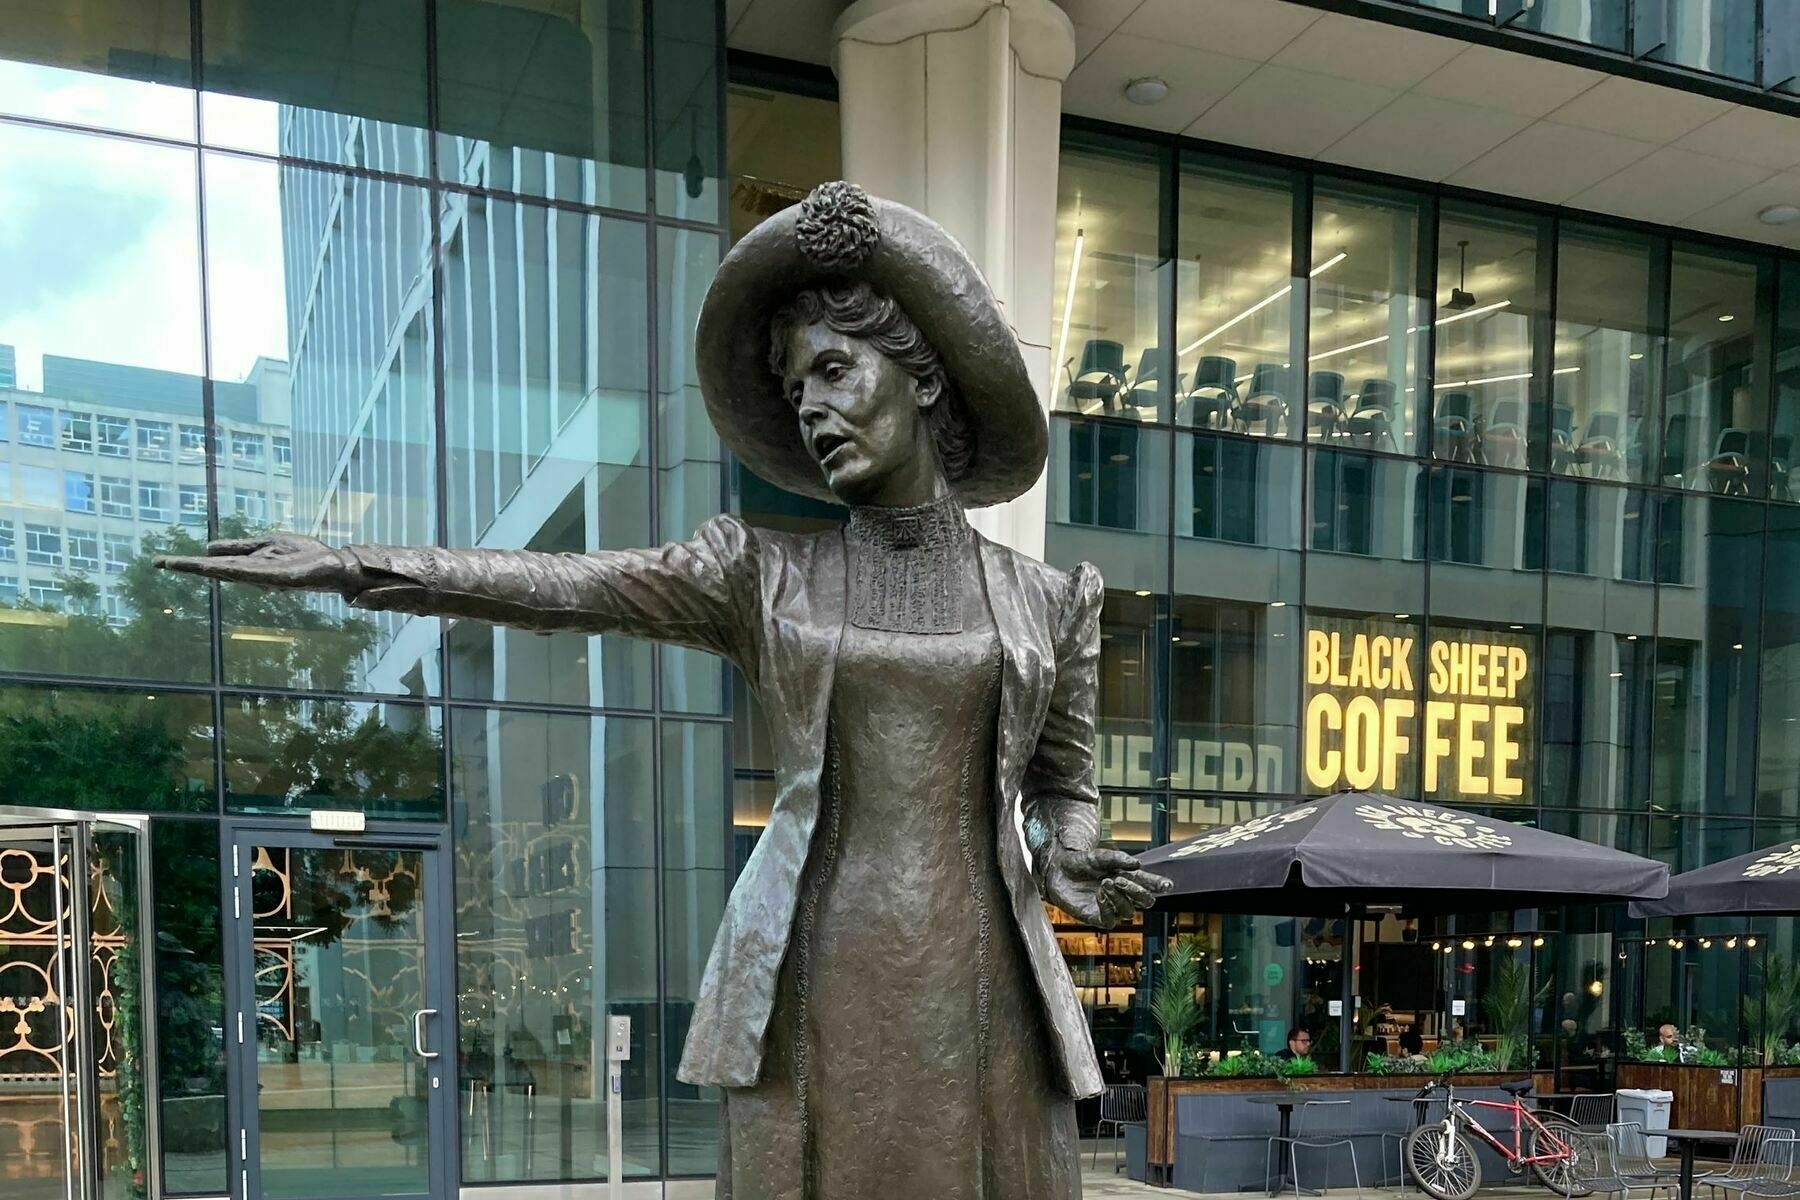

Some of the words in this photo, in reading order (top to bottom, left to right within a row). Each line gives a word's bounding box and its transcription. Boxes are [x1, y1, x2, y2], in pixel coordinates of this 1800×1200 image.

[1307, 629, 1414, 691] BLACK
[1429, 640, 1528, 699] SHEEP
[1305, 692, 1525, 796] COFFEE
